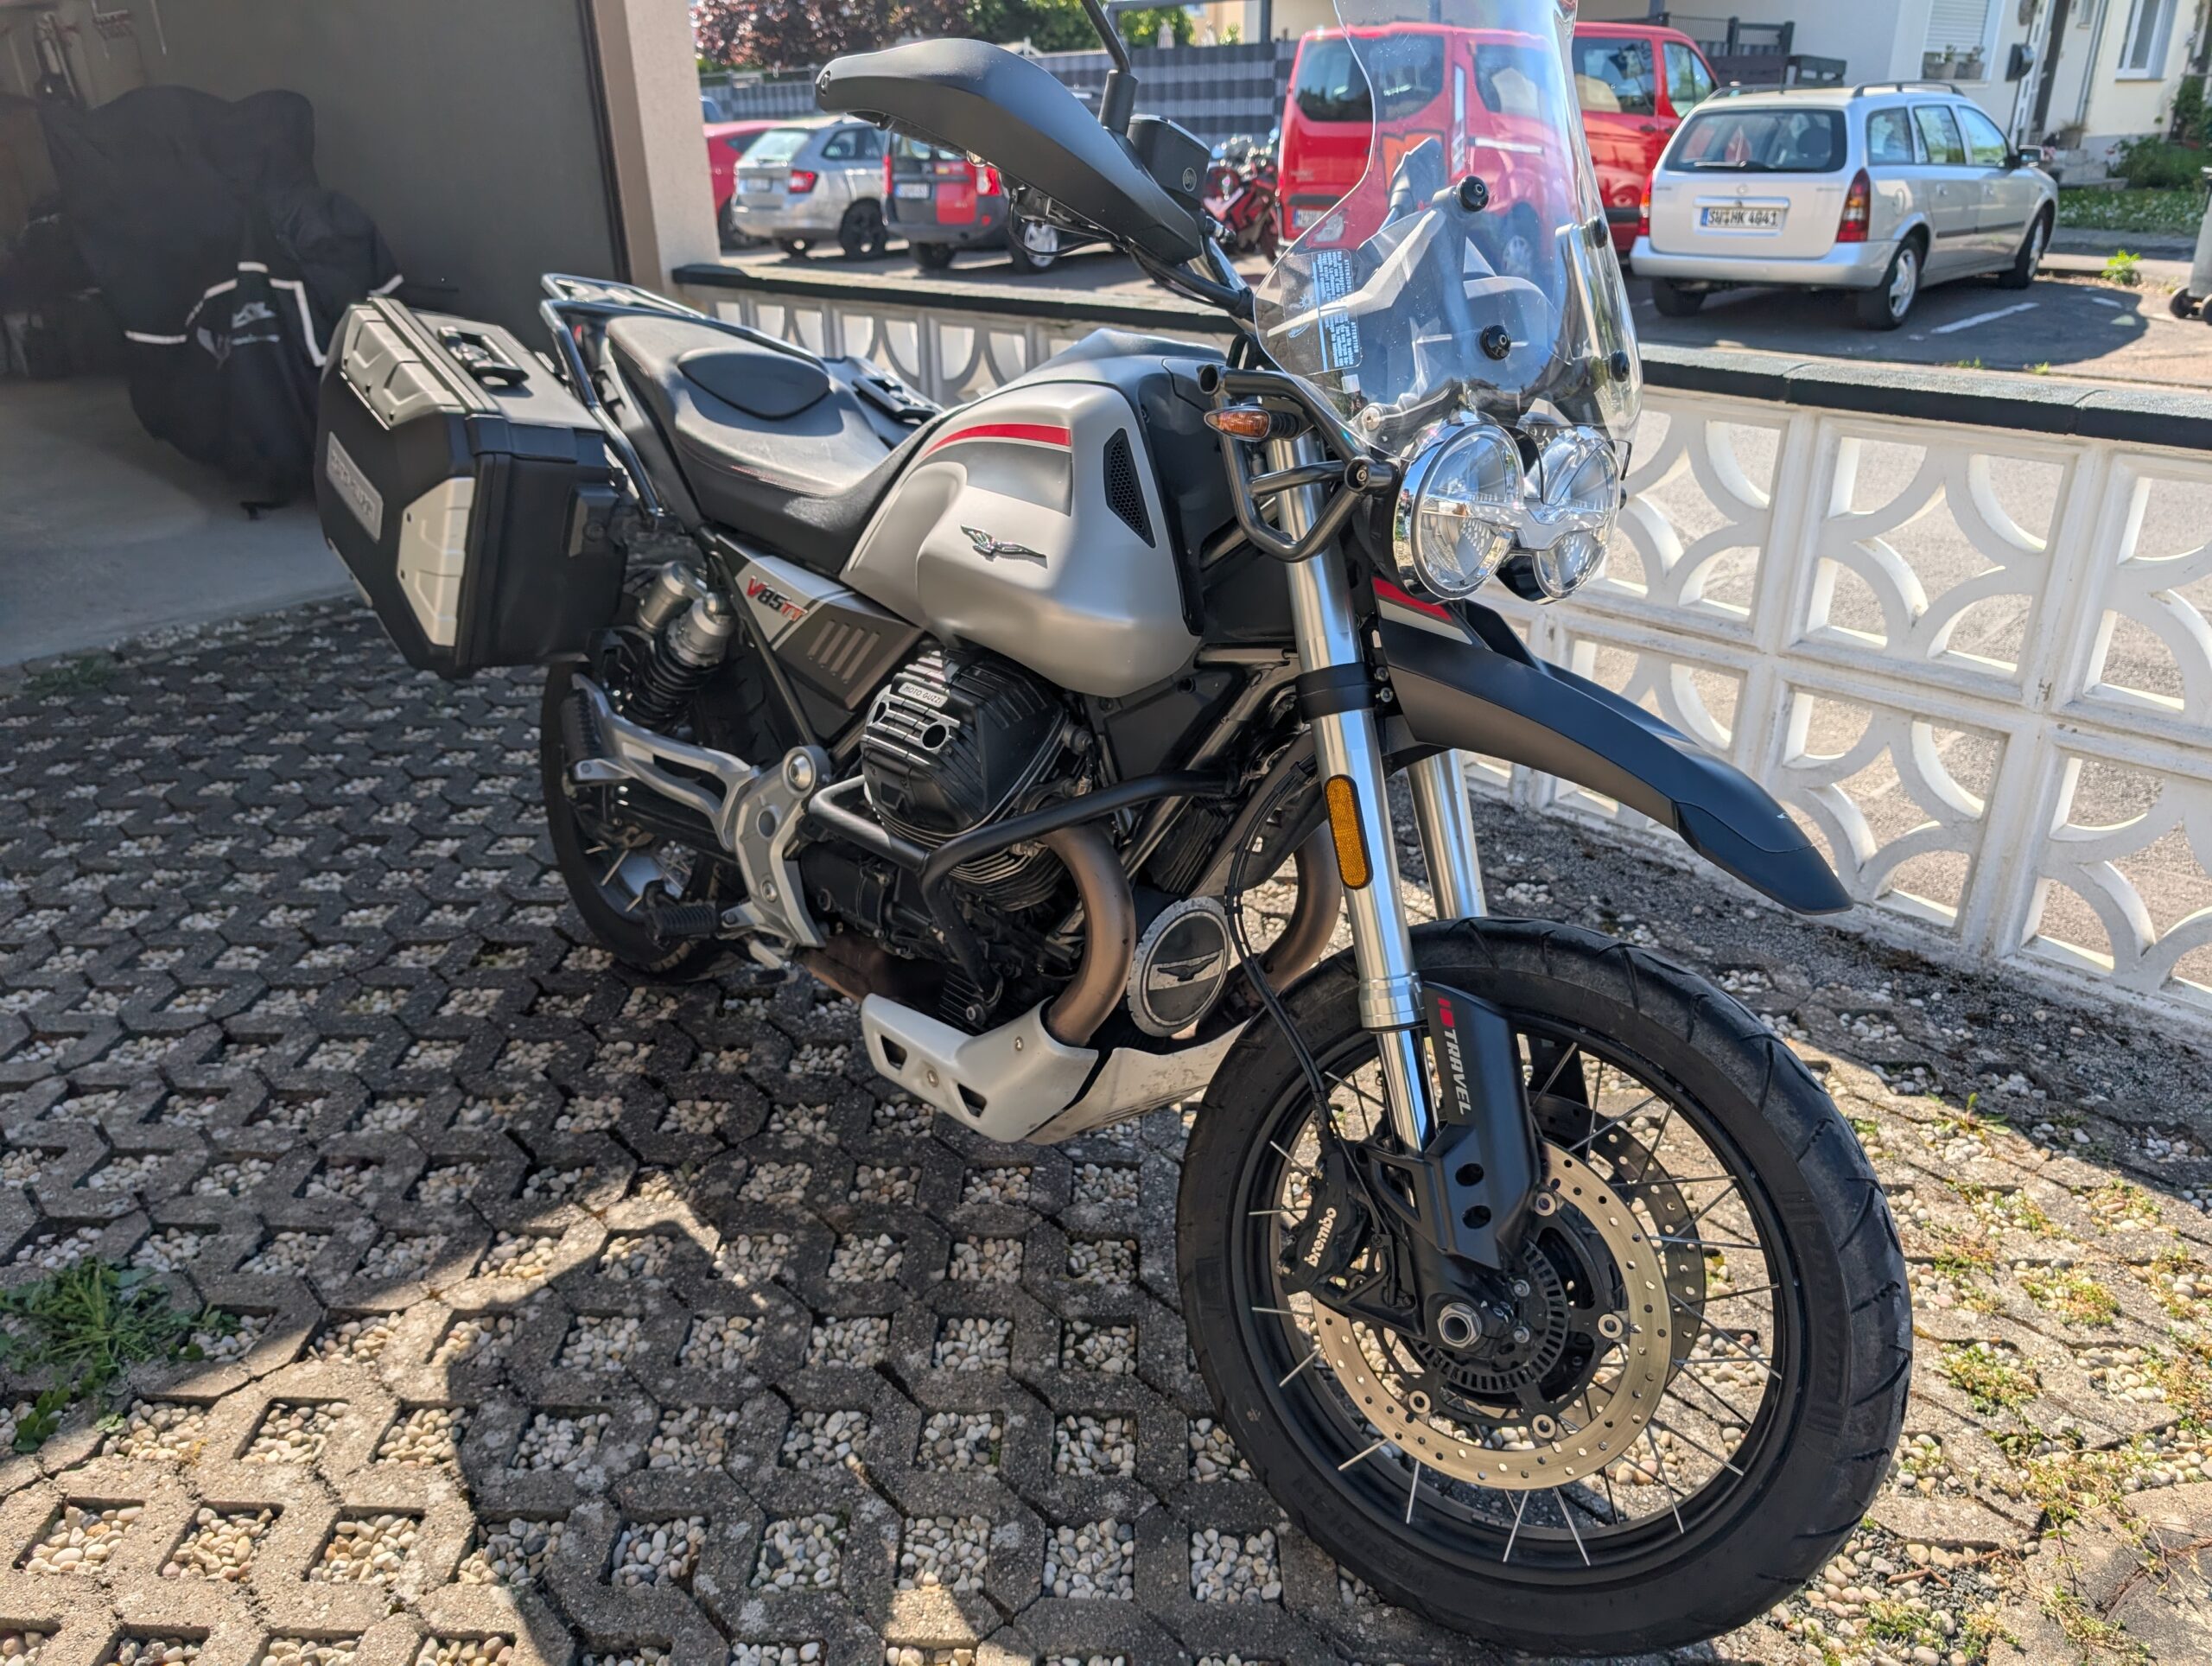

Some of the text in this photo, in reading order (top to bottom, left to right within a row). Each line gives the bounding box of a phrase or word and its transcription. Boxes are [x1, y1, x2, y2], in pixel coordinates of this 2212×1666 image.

[1351, 321, 1359, 353] ATTENTION
[747, 575, 808, 621] V85TT
[904, 685, 941, 704] MOTO GUZZI
[1444, 1028, 1471, 1115] TRAVEL
[1304, 1207, 1337, 1268] brembo
